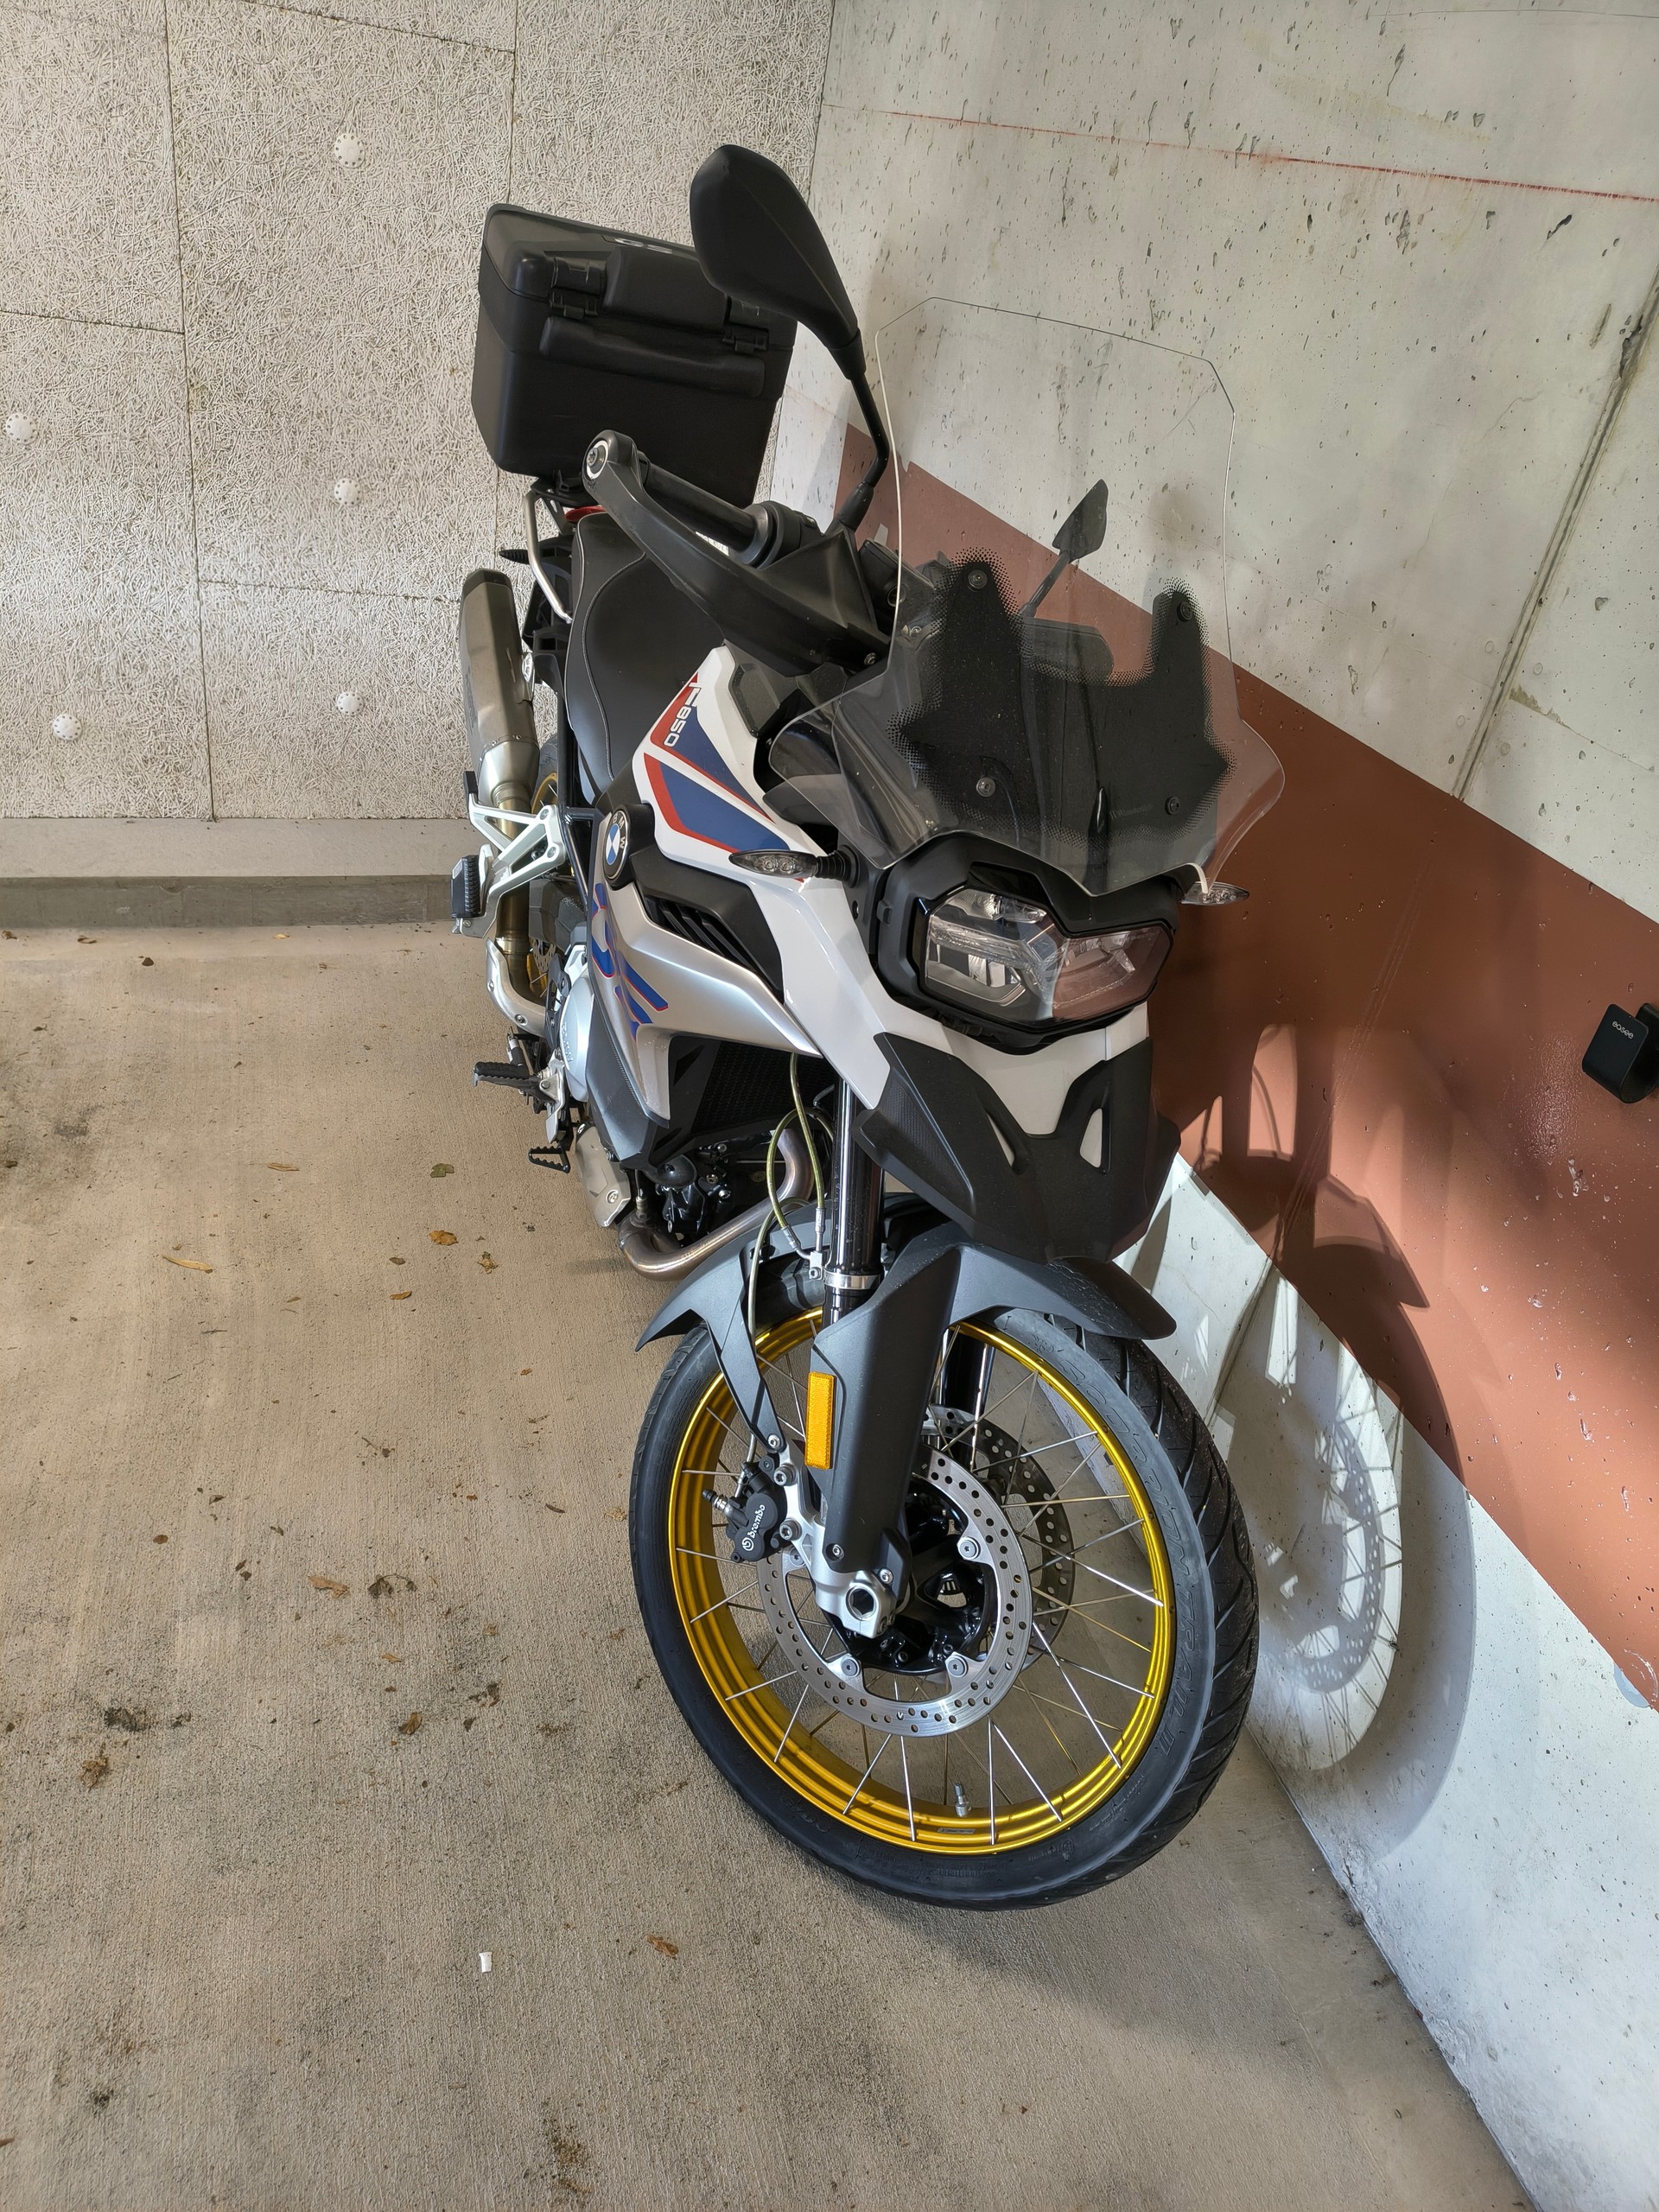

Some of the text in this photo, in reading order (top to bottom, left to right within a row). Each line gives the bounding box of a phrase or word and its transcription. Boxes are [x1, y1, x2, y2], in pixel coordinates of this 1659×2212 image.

[612, 813, 626, 849] BMW
[1611, 1020, 1634, 1039] easee
[747, 1503, 766, 1539] brembo
[1056, 1359, 1191, 1576] SCORPION
[1168, 1590, 1195, 1718] TRAIL
